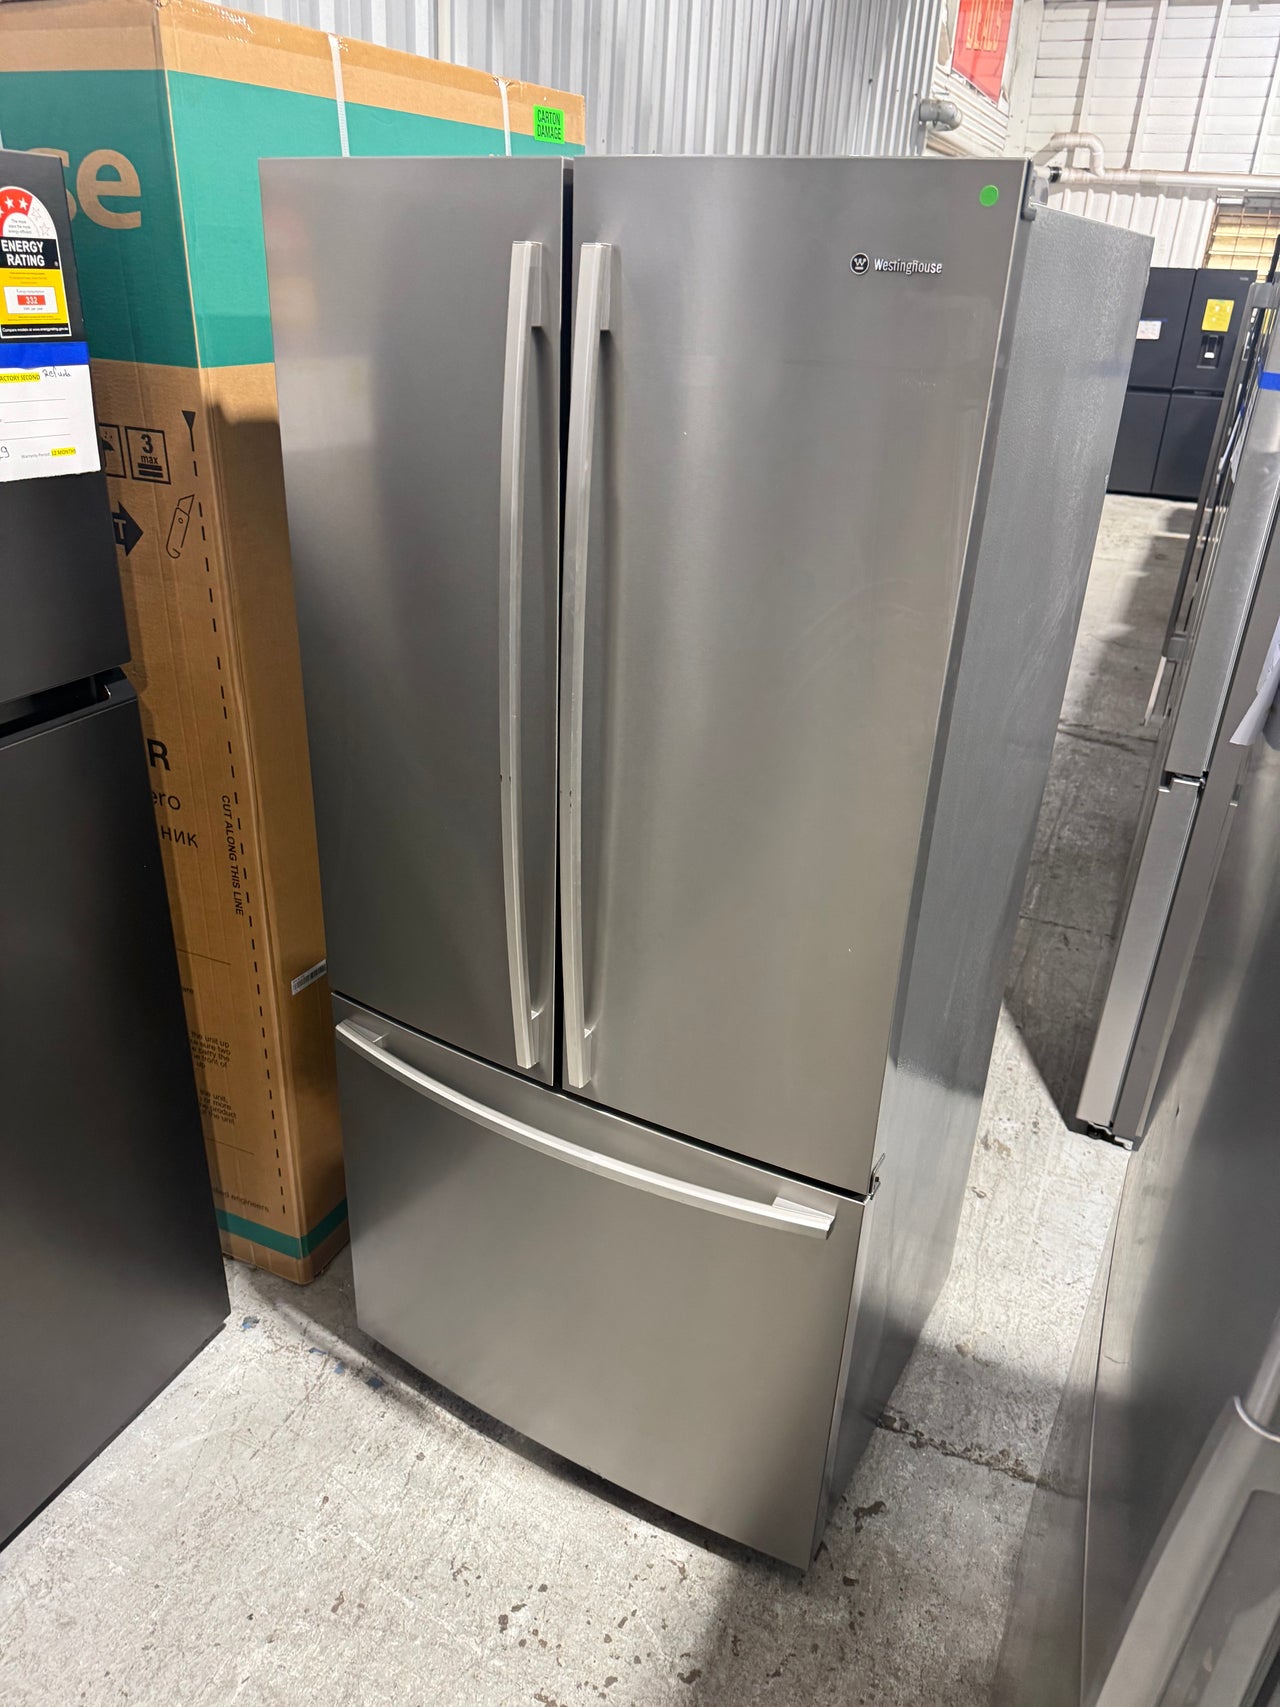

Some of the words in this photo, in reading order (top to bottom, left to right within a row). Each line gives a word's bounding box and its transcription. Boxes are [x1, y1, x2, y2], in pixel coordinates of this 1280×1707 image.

[537, 109, 561, 126] CARTON
[537, 124, 562, 140] DAMAGE
[28, 147, 142, 230] e
[1, 239, 44, 253] ENERGY
[6, 253, 45, 267] RATING
[874, 258, 943, 275] Westinghouse
[25, 296, 38, 305] 332
[0, 446, 10, 458] 9
[141, 434, 153, 454] 3
[141, 455, 158, 465] max
[221, 795, 232, 819] CUT
[224, 820, 237, 862] ALONG
[230, 864, 241, 889] THIS
[233, 891, 244, 917] LINE
